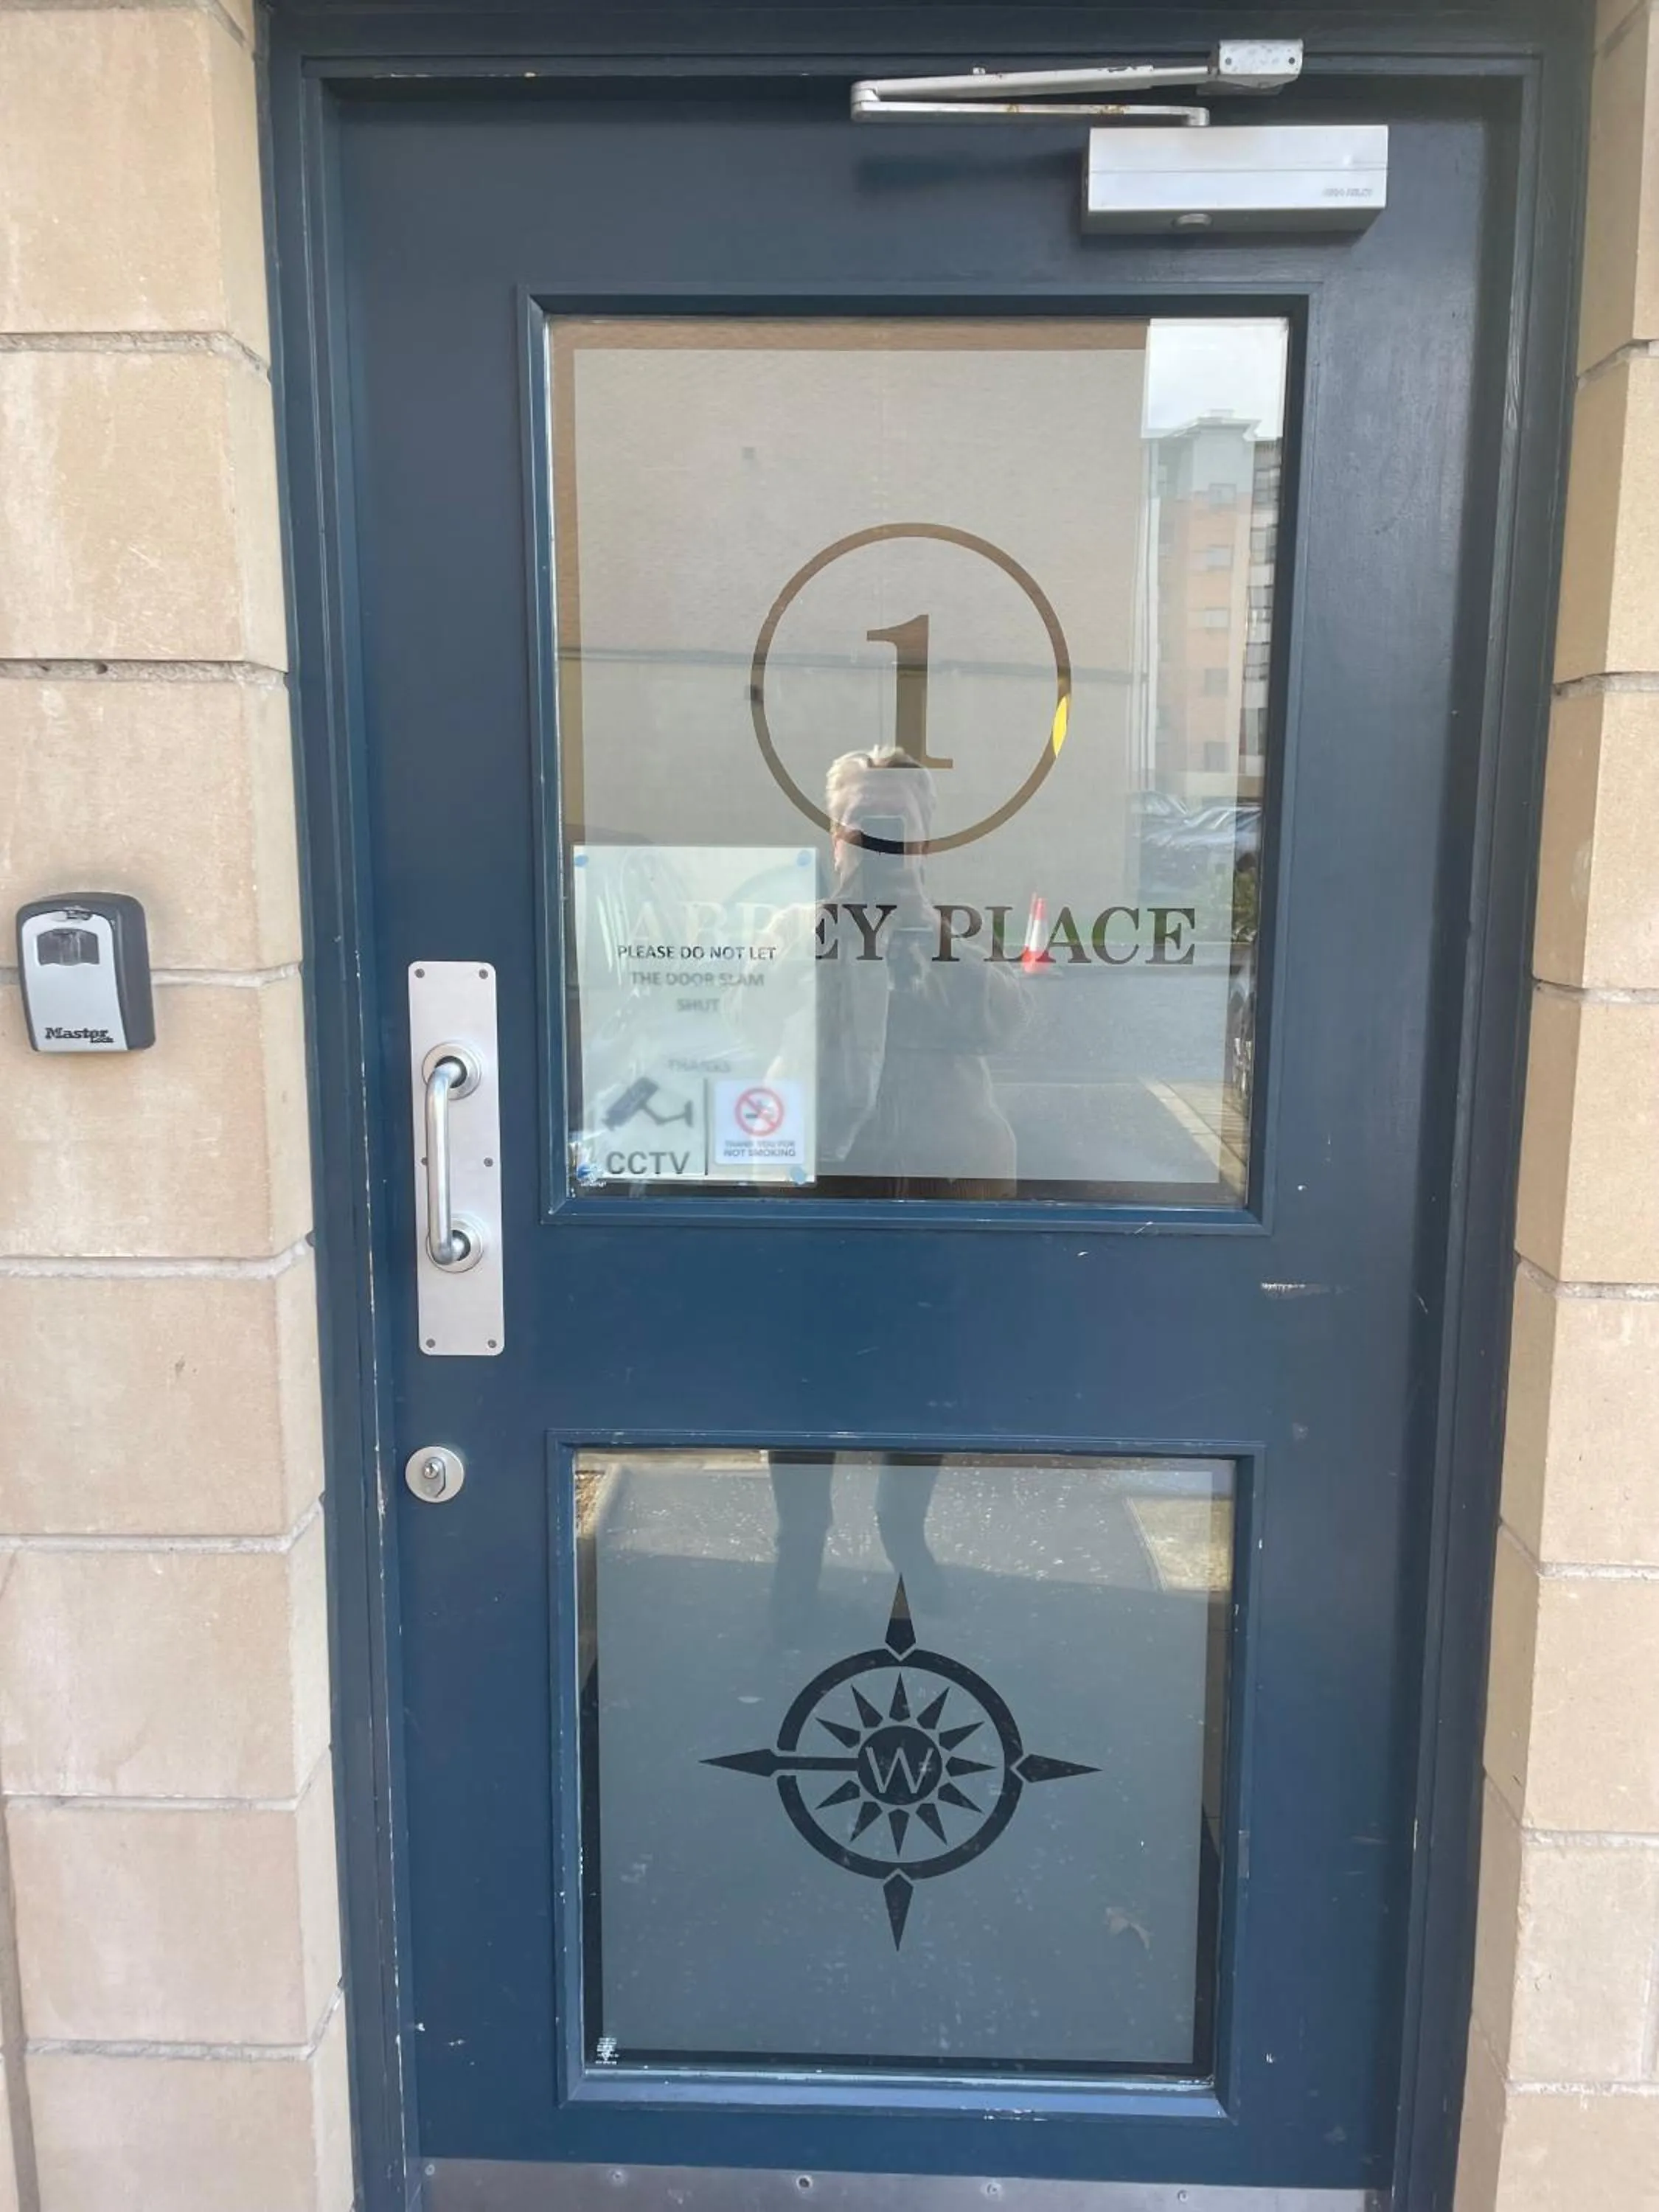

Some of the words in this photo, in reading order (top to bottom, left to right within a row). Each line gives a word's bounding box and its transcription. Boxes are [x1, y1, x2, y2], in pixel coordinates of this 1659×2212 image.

[867, 614, 953, 768] 1
[932, 905, 1195, 964] PLACE
[618, 945, 675, 959] PLEASE
[681, 946, 704, 959] DO
[710, 947, 745, 959] NOT
[750, 947, 776, 960] LET
[631, 971, 662, 986] THE
[666, 972, 714, 986] DOOR
[719, 973, 764, 987] SLAM
[677, 998, 720, 1012] SHUT
[45, 1027, 108, 1039] Master
[724, 1148, 745, 1157] NOT
[748, 1148, 796, 1157] SMOKING
[606, 1151, 690, 1175] CCTV
